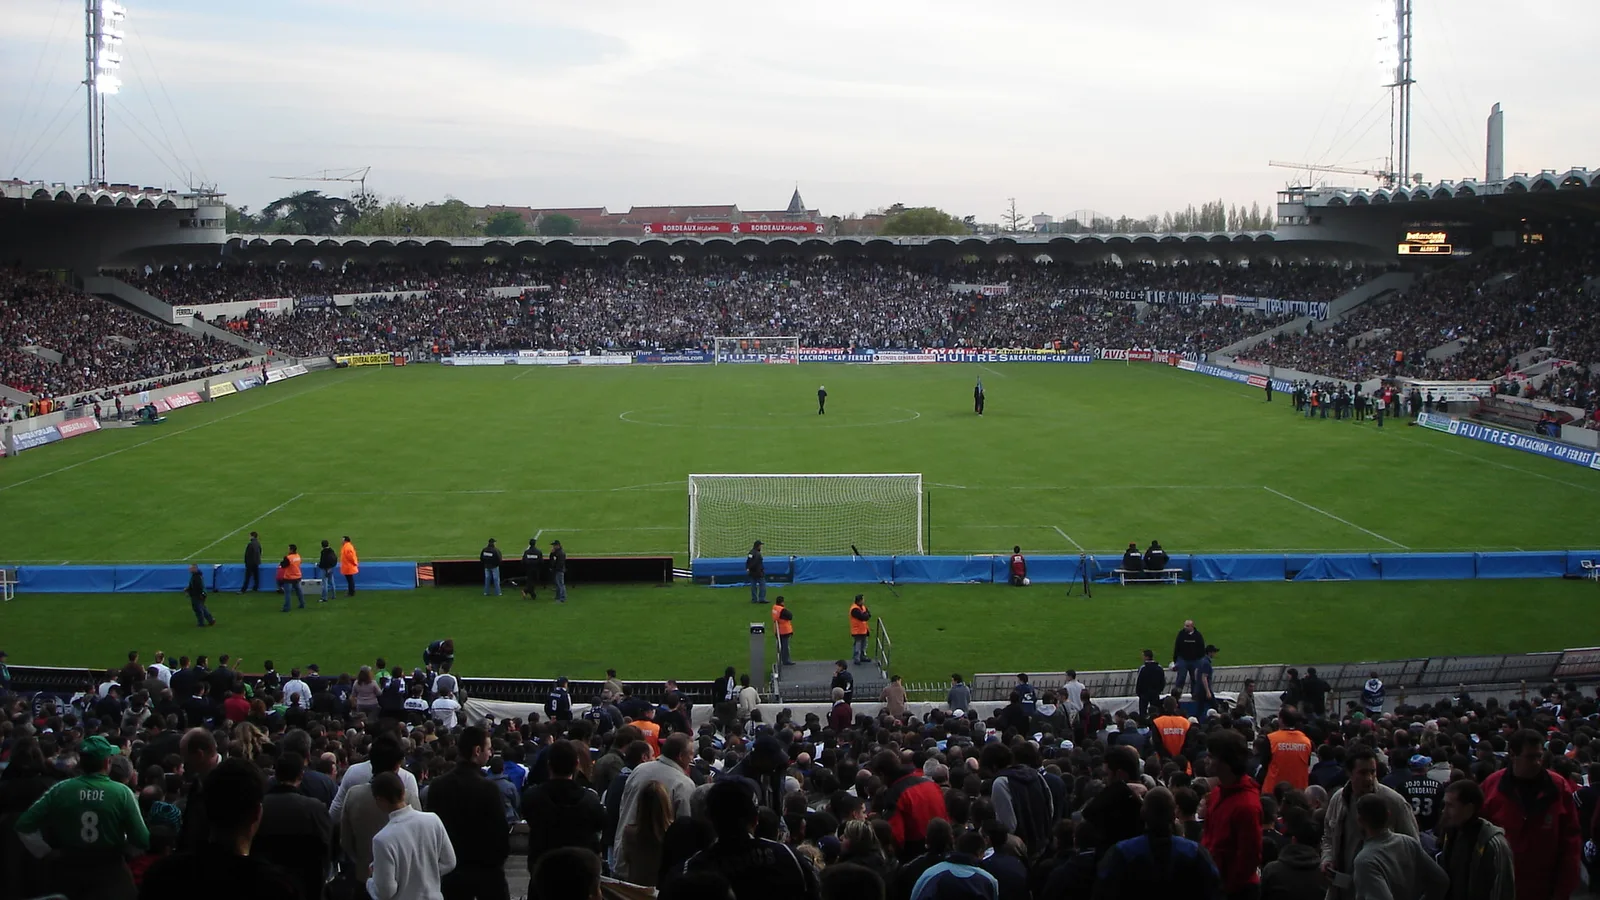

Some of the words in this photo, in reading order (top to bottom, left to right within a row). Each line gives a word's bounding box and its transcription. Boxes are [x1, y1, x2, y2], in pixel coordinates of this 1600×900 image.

[937, 354, 1007, 362] HUITRES
[1104, 349, 1127, 359] AVIS
[1196, 362, 1220, 377] HUITRES
[1459, 423, 1517, 446] HUITRES
[1517, 436, 1548, 453] ARCACHON
[1554, 445, 1567, 457] CAP
[1567, 449, 1591, 463] FERRET
[552, 699, 558, 711] 9
[1404, 779, 1421, 788] JOJO
[80, 789, 104, 801] DEDE
[1408, 787, 1437, 795] BORDEAUX
[1411, 797, 1433, 816] 33
[80, 810, 99, 843] 8
